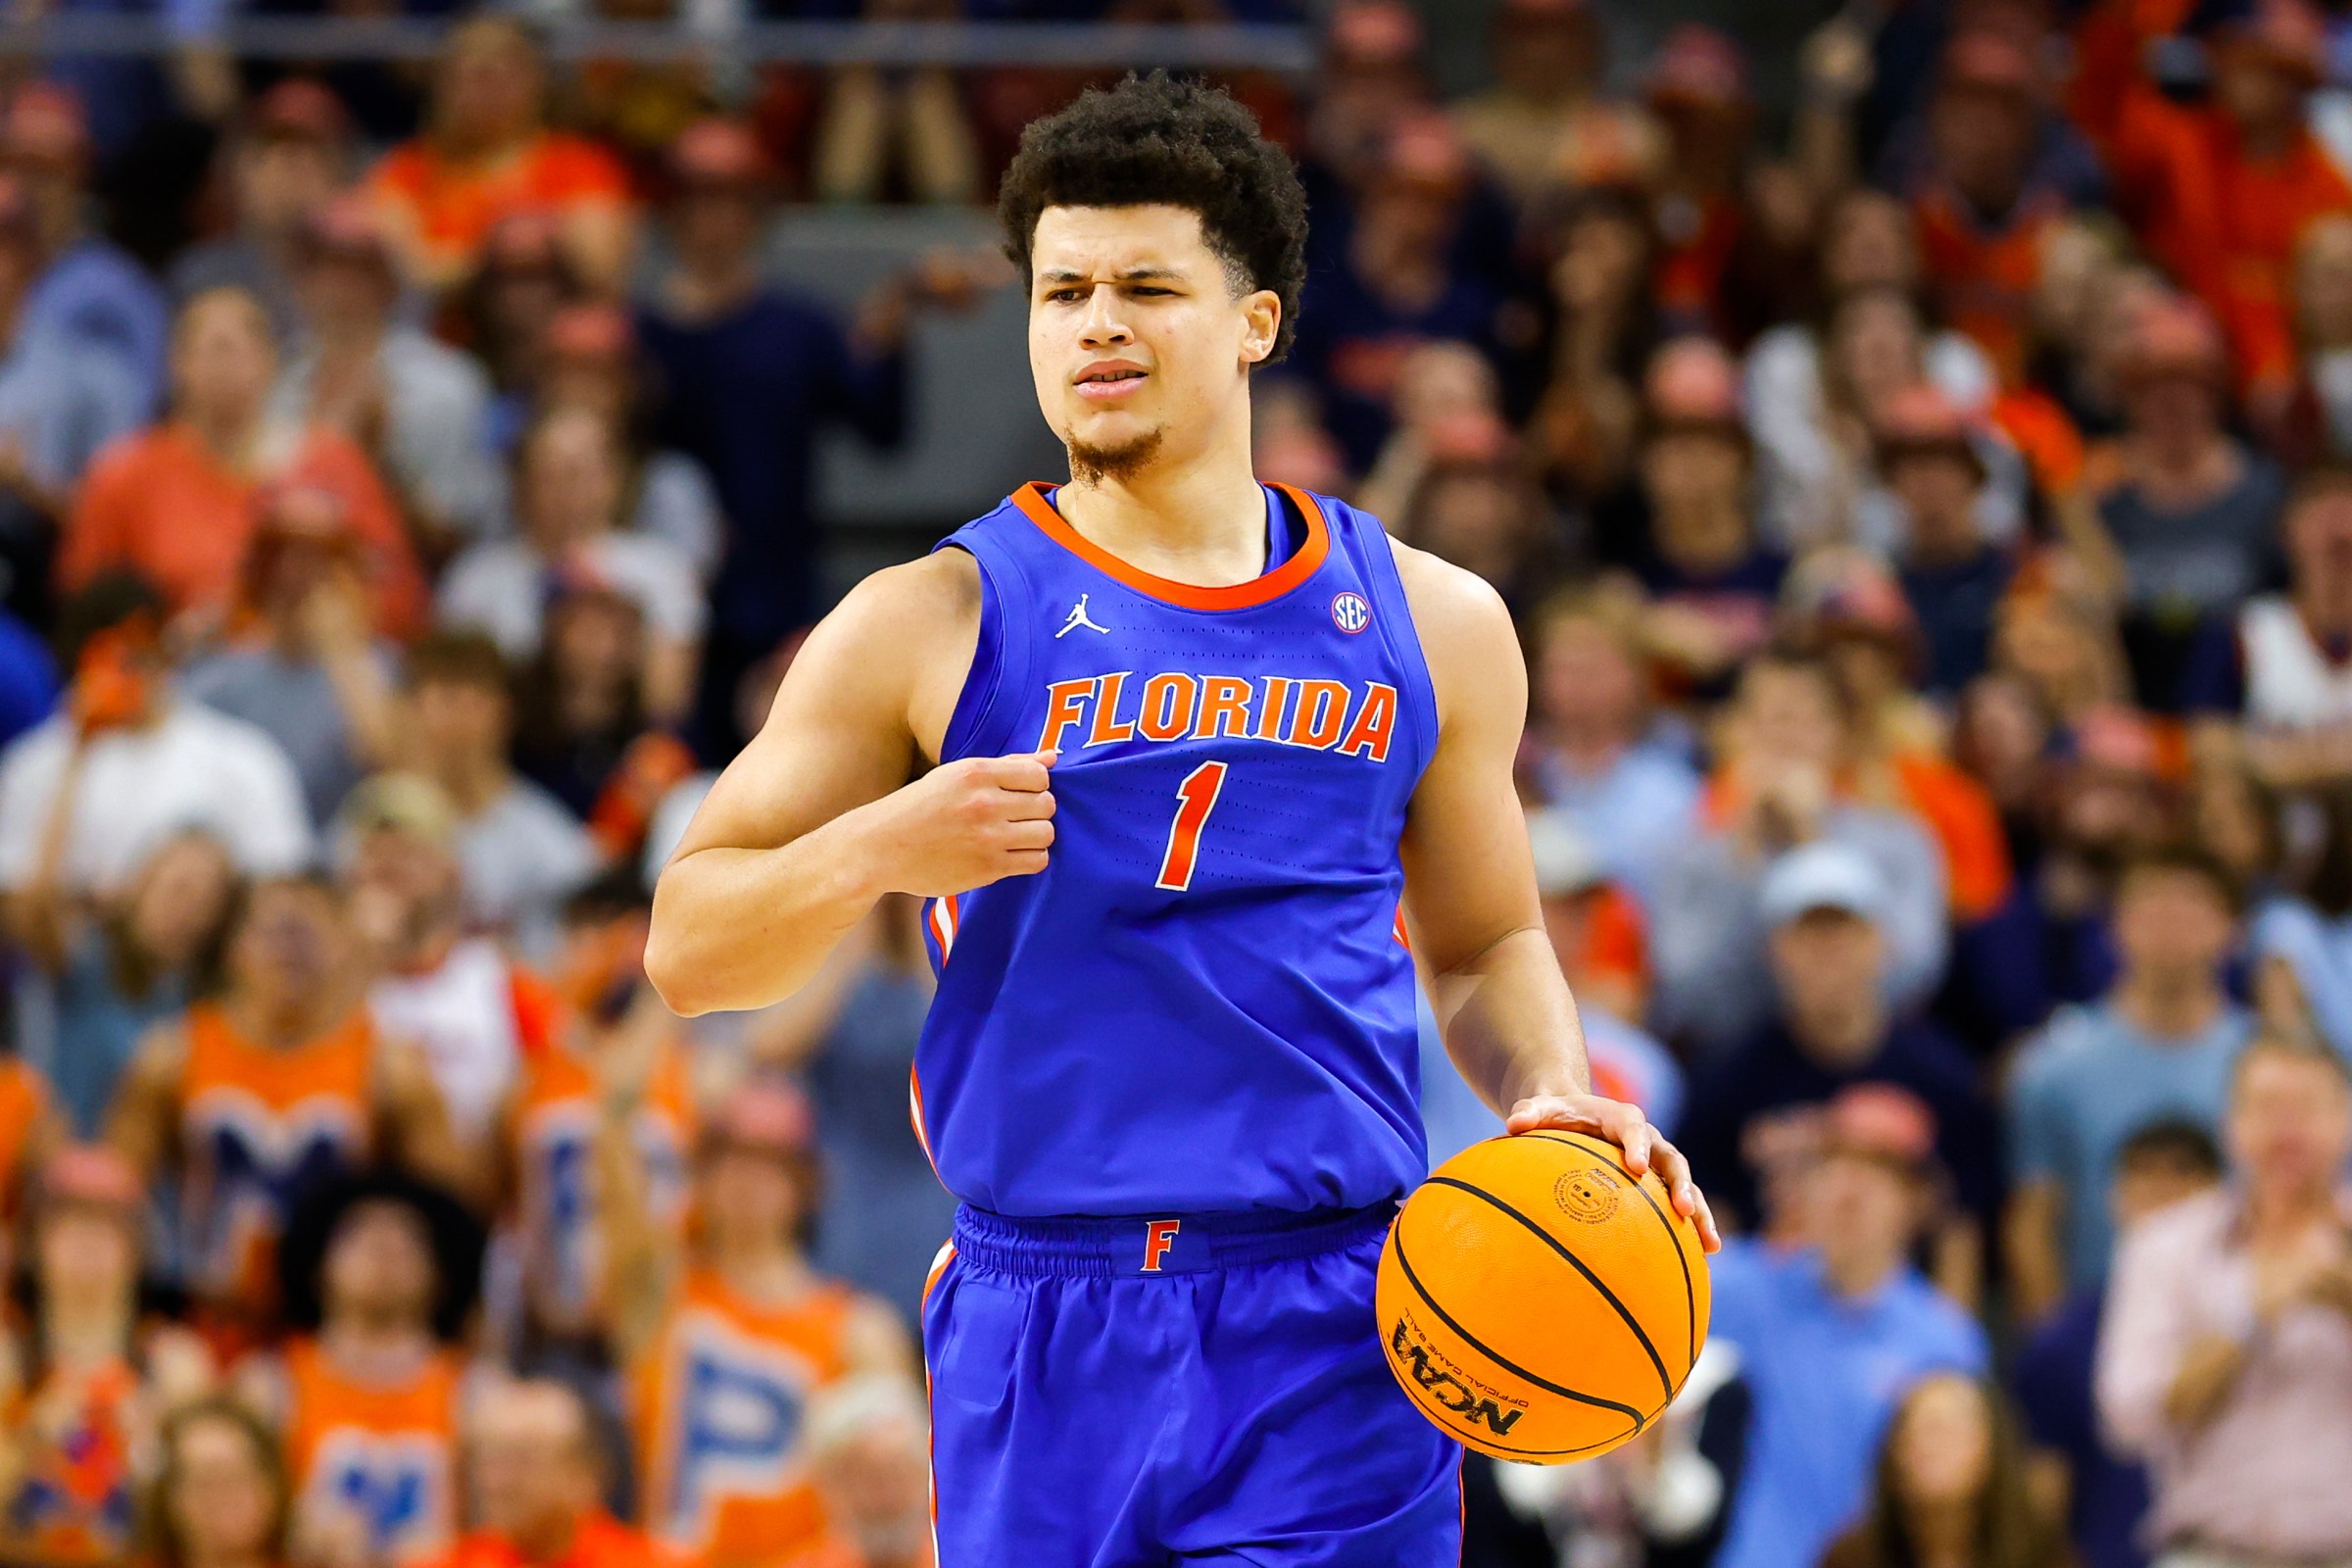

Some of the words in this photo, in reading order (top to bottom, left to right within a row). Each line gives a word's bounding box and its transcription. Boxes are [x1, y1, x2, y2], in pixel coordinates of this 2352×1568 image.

[1334, 595, 1367, 630] SEC
[1035, 671, 1397, 763] FLORIDA
[1154, 760, 1229, 892] 1
[1140, 1219, 1181, 1272] F
[1404, 1306, 1427, 1343] BALL
[1392, 1316, 1526, 1437] NCAA
[1427, 1343, 1463, 1376] GAME
[1465, 1374, 1530, 1408] OFFICIAL
